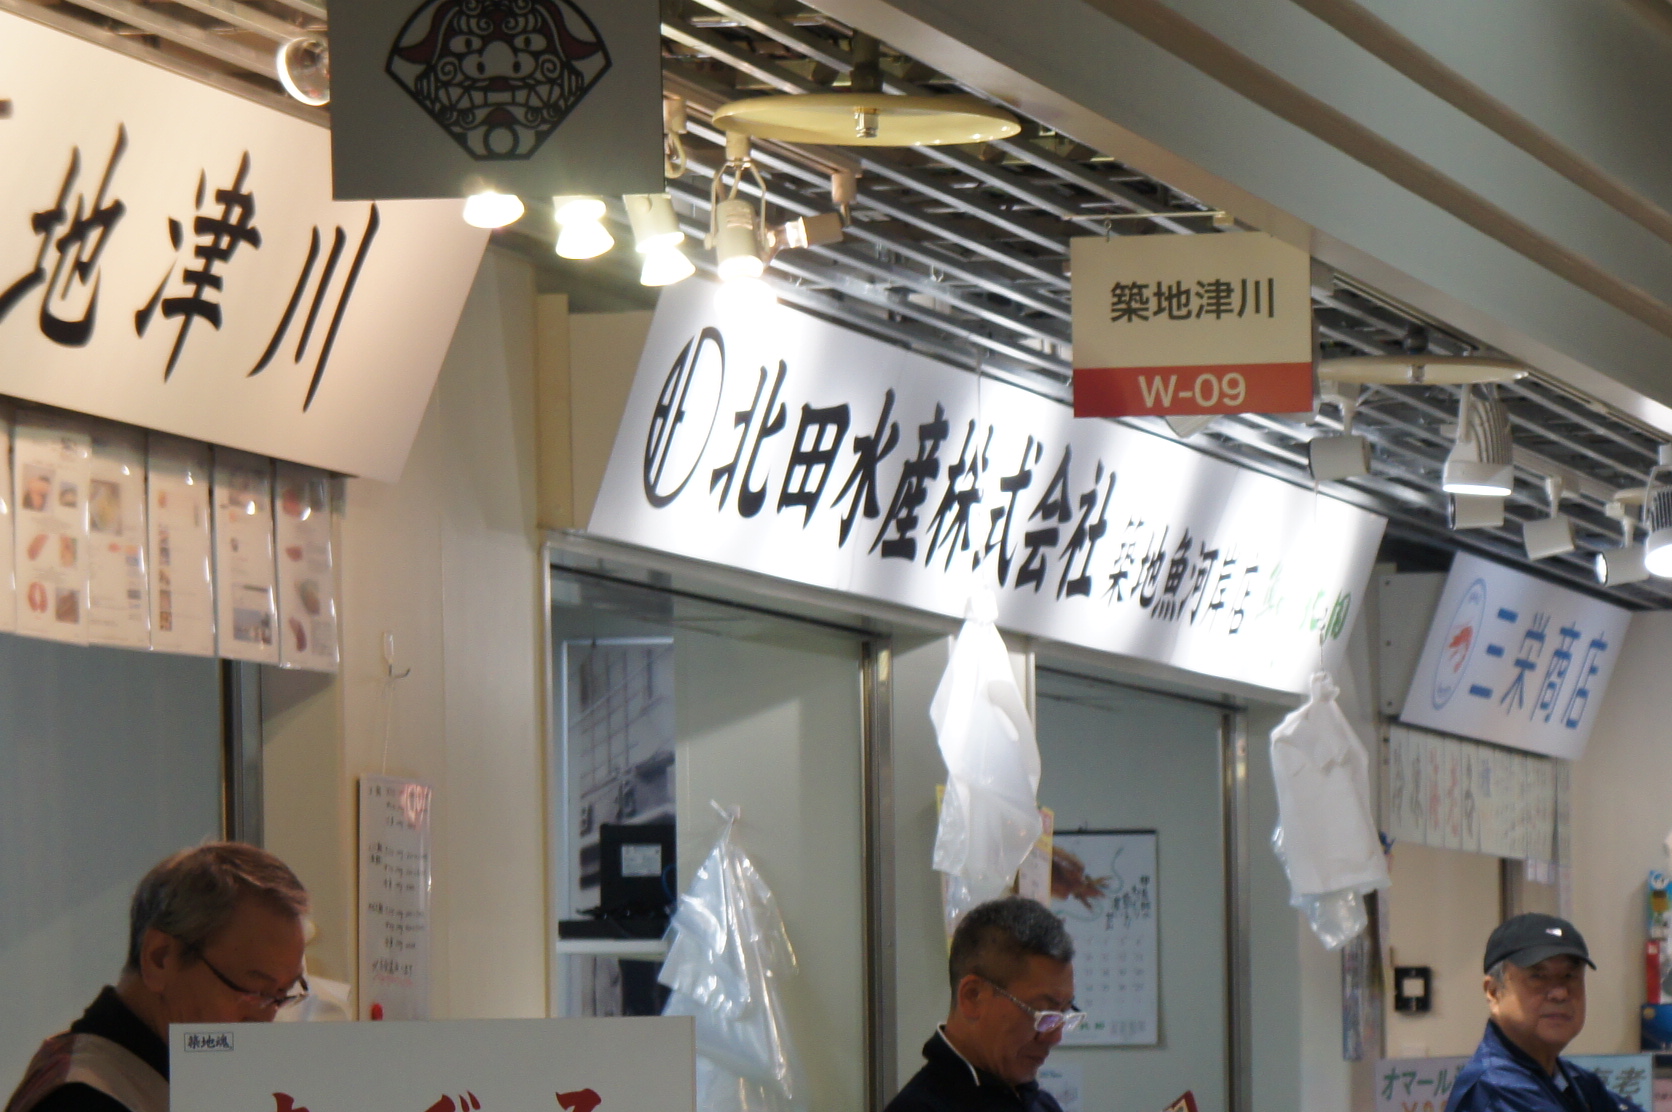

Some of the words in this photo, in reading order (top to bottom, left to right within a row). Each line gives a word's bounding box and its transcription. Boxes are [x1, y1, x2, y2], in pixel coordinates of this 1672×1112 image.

[0, 98, 381, 413] 地津川
[1110, 277, 1275, 324] 築地津川
[1138, 372, 1247, 409] W-09
[710, 358, 1118, 601] 北田水産株式会社
[1468, 606, 1609, 730] 三栄商店
[1381, 1065, 1464, 1101] オマール
